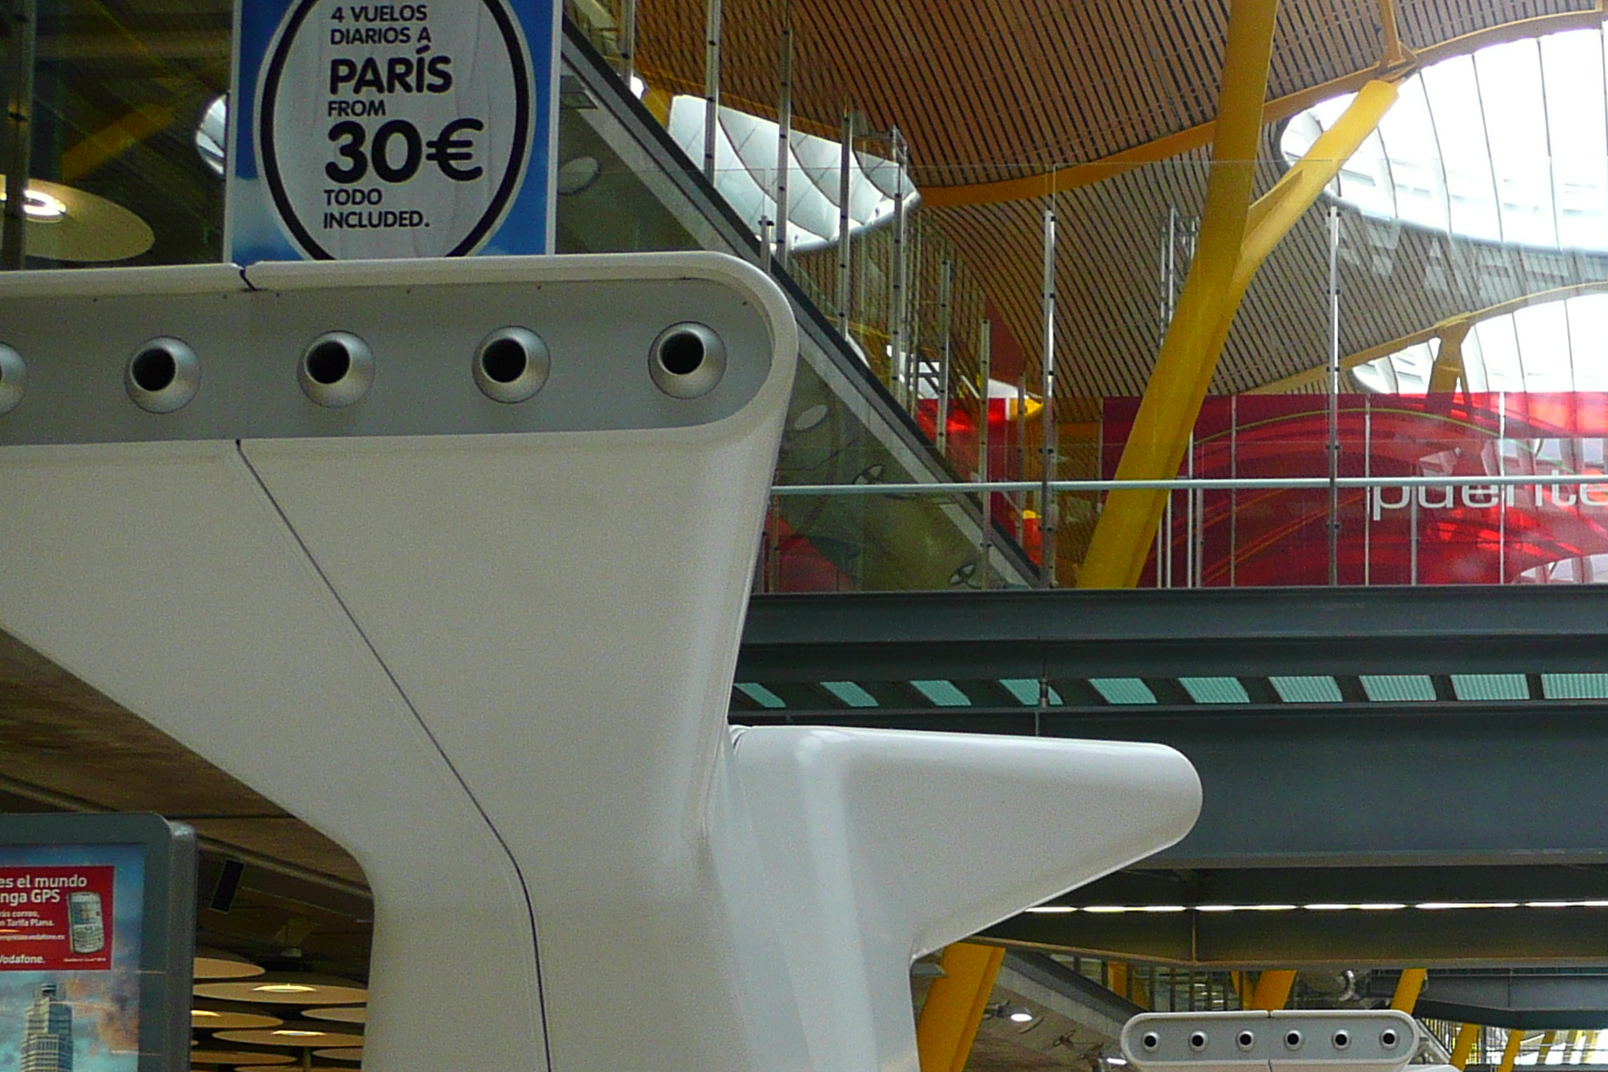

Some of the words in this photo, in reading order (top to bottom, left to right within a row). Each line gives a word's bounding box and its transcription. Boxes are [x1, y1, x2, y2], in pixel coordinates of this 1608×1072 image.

[330, 6, 345, 23] 4
[351, 4, 428, 23] VUELOS
[330, 27, 412, 46] DIARIOS
[416, 26, 432, 44] A
[329, 45, 453, 96] PARÍS
[327, 99, 387, 118] FROM
[324, 117, 485, 184] 30€
[323, 188, 383, 207] TODO
[322, 210, 431, 230] INCLUDED.
[17, 874, 31, 888] el
[34, 873, 88, 888] mundo
[31, 888, 61, 903] GPS
